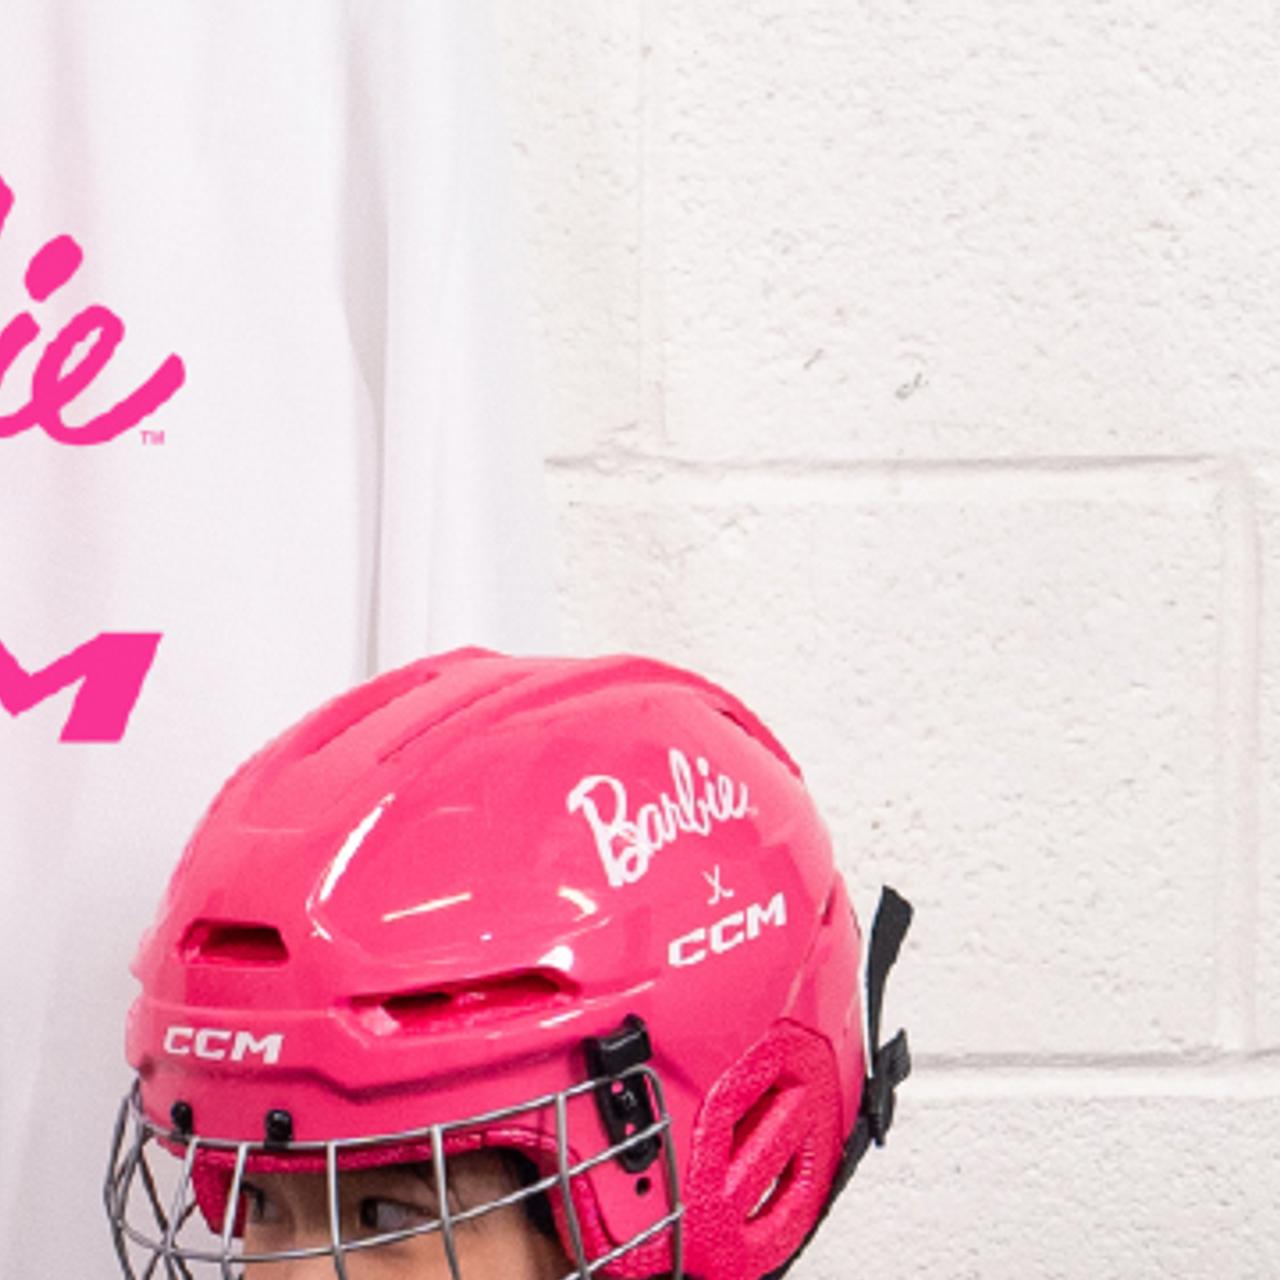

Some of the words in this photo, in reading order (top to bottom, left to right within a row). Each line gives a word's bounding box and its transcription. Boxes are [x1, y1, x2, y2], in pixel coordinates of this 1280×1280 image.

[566, 747, 749, 887] Barbie
[668, 892, 787, 967] CCM
[163, 1026, 285, 1065] CCM
